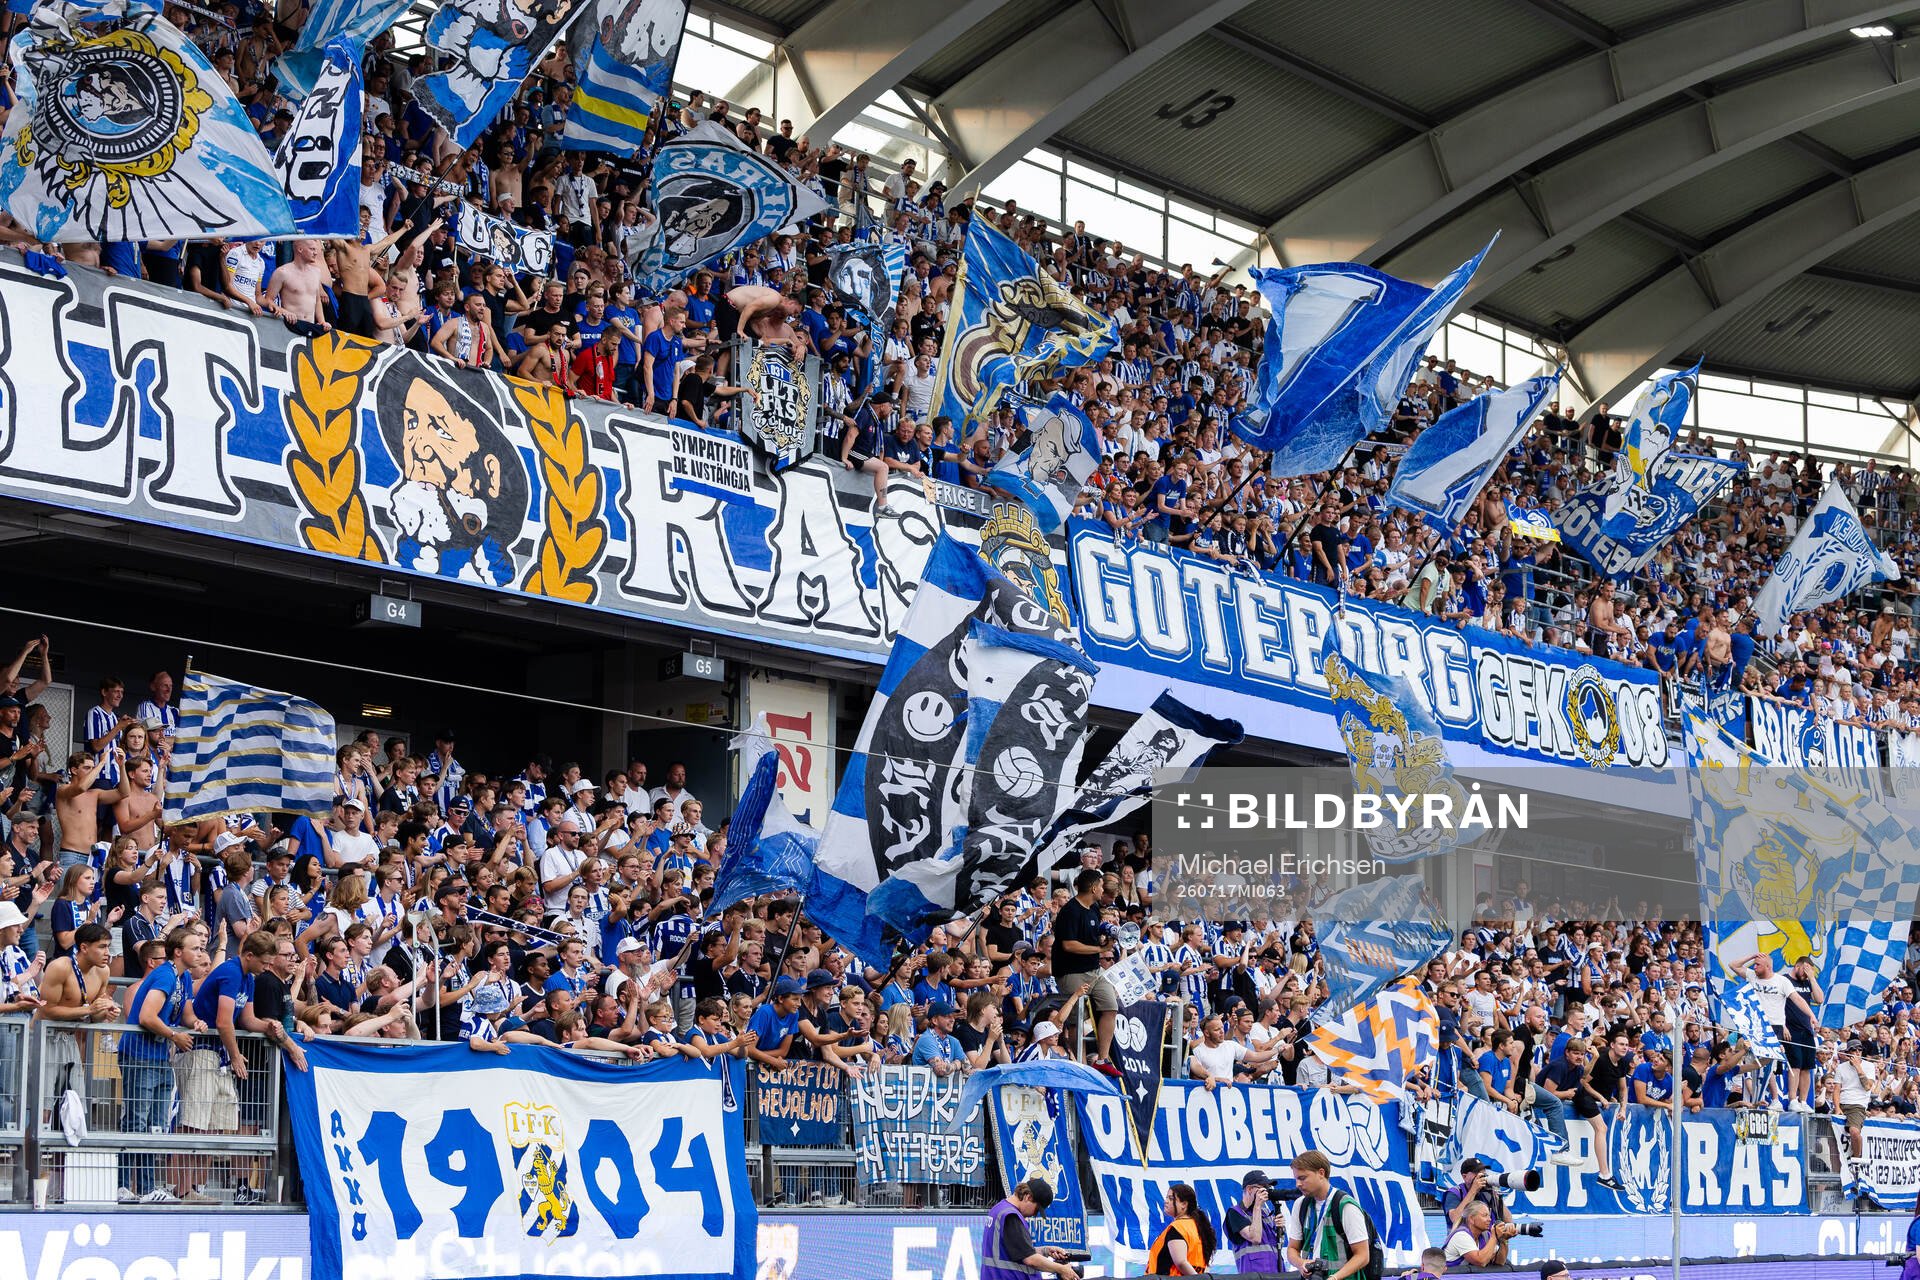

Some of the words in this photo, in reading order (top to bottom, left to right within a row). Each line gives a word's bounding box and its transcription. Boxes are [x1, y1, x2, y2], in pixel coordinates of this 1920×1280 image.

[1153, 88, 1237, 130] J3
[671, 430, 727, 464] SYMPATI
[729, 444, 749, 471] FÖR
[673, 455, 689, 475] DE
[387, 601, 406, 621] G4
[695, 657, 713, 677] G5
[1478, 650, 1576, 758] GFK
[1617, 681, 1669, 769] 08
[1122, 1054, 1151, 1075] 2014
[1748, 1112, 1768, 1136] GBG
